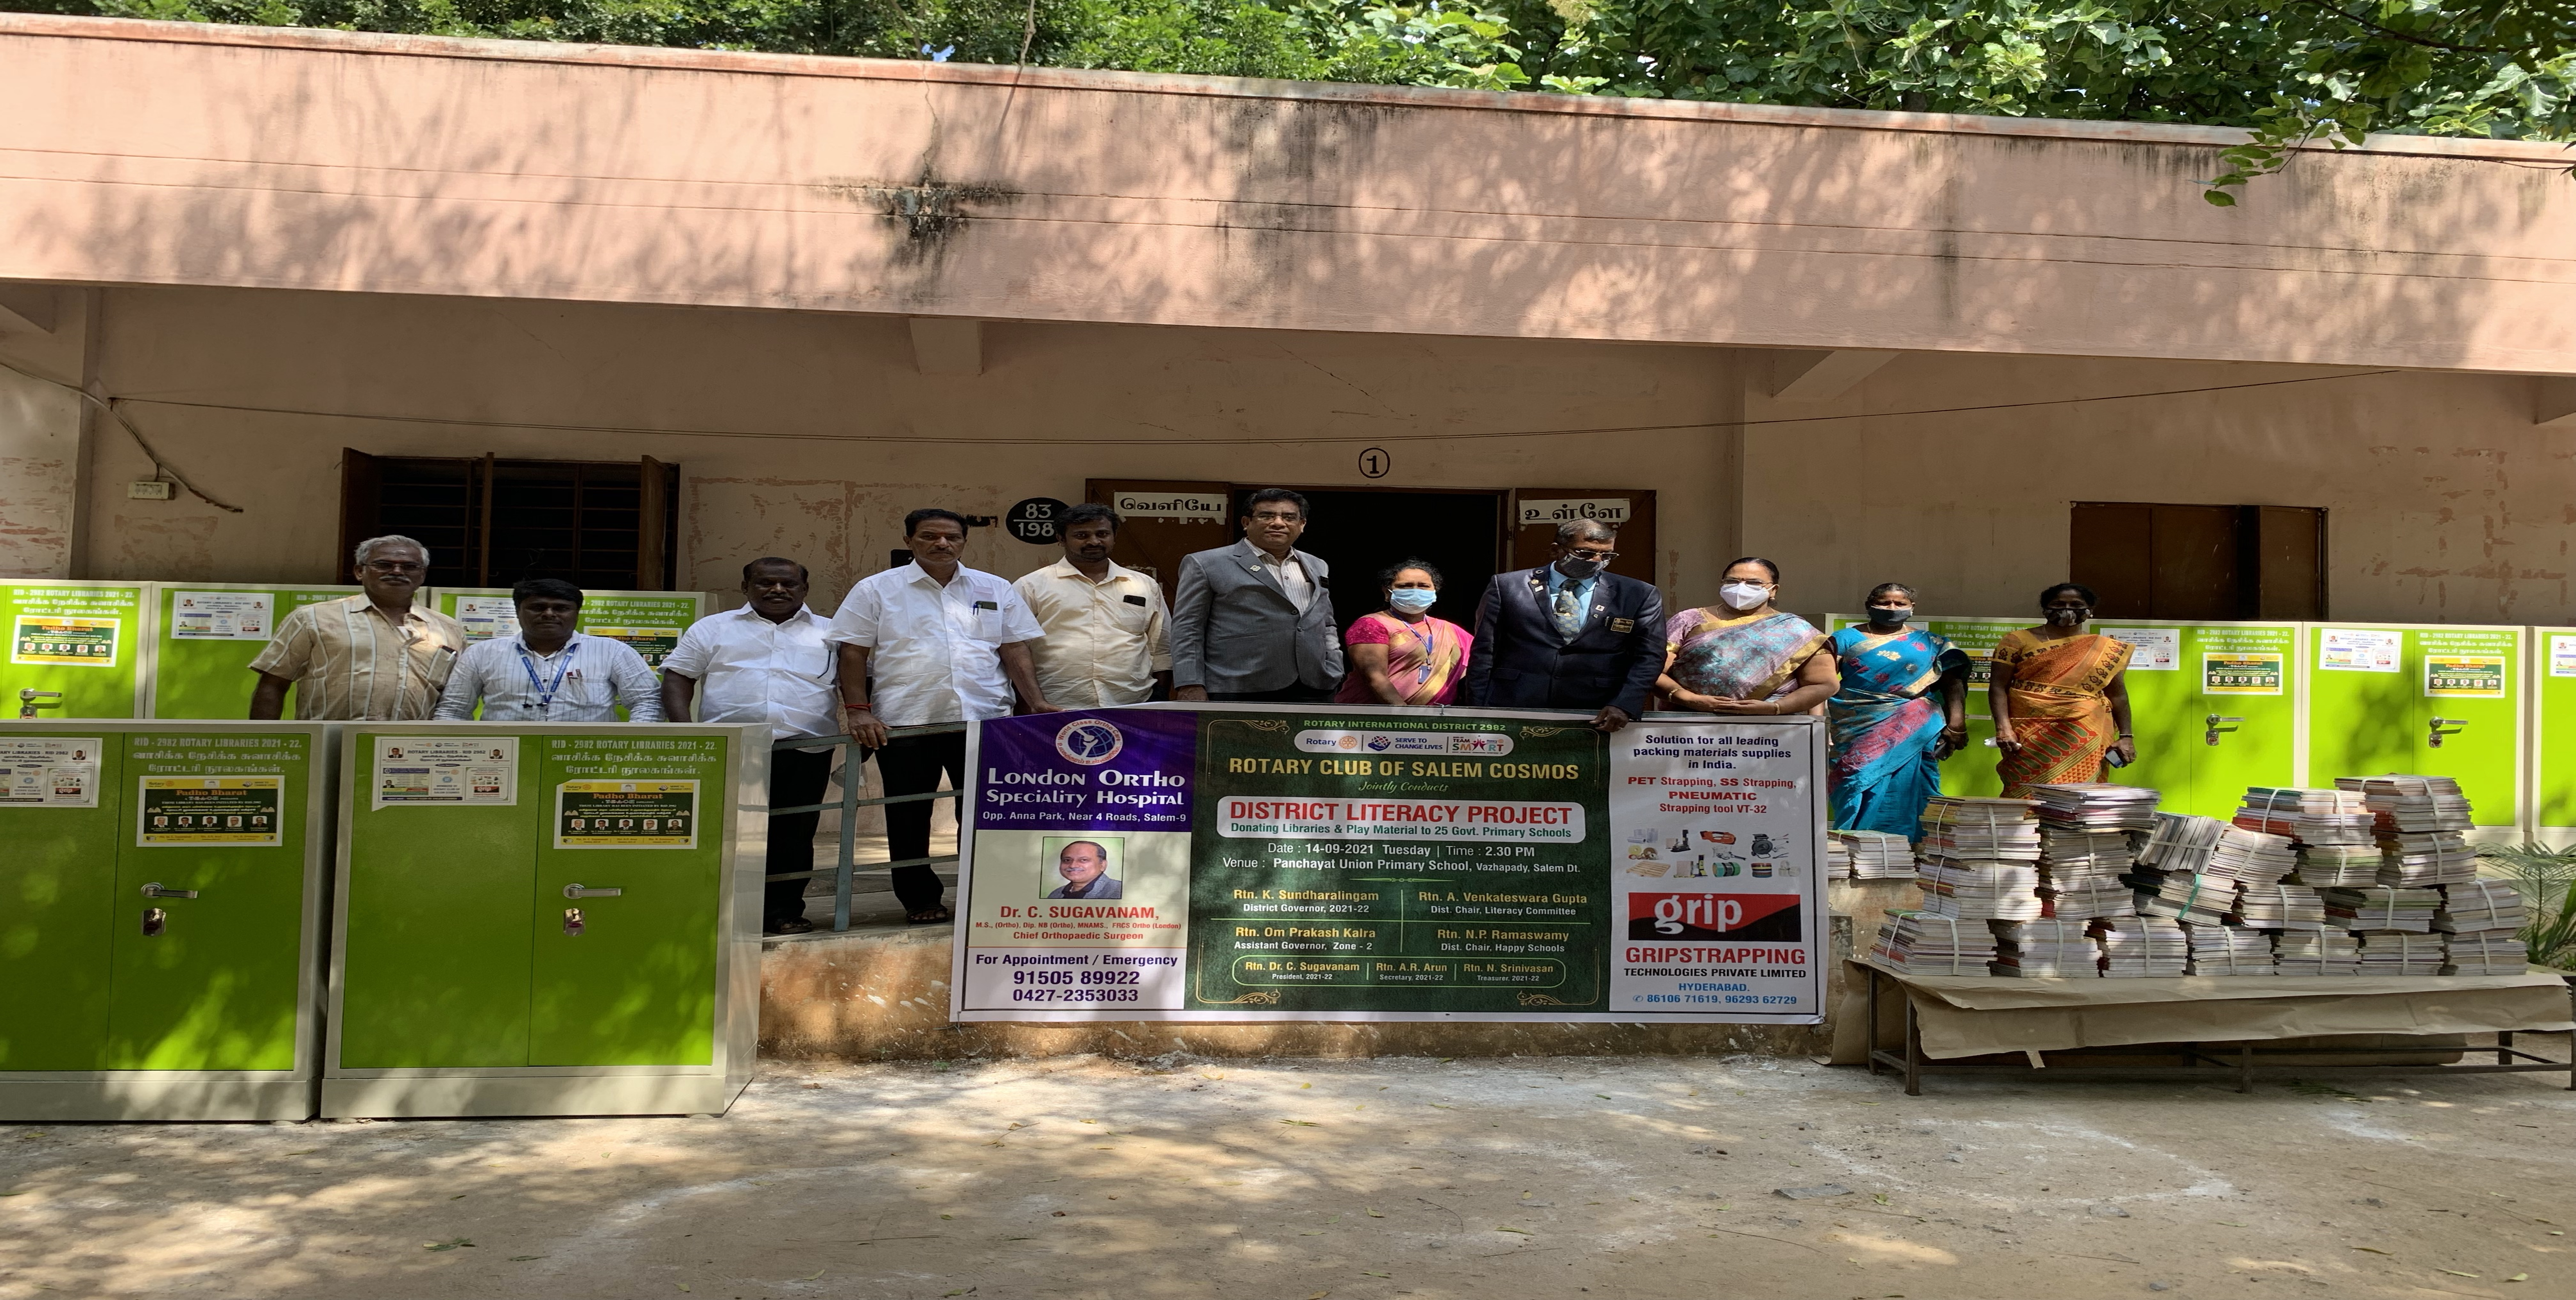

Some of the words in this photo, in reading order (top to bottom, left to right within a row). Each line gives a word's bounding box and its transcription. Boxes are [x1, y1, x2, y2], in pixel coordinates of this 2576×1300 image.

[1366, 455, 1379, 474] 1
[1025, 503, 1051, 519] 83
[1120, 497, 1222, 512] வெளியே
[1524, 502, 1624, 520] உள்ளே
[1018, 522, 1055, 537] 198
[1057, 726, 1072, 740] World
[1094, 720, 1113, 730] Ortho
[1112, 730, 1121, 741] Care
[1348, 721, 1430, 729] INTERNATIONAL
[134, 737, 149, 746] RID
[180, 738, 212, 747] ROTARY
[215, 739, 259, 747] LIBRARIES
[262, 739, 281, 748] 2021
[552, 740, 566, 749] RID
[596, 740, 629, 749] ROTARY
[631, 741, 675, 750] LIBRARIES
[677, 741, 697, 750] 2021
[1306, 738, 1336, 746] Rotary
[1645, 735, 1694, 744] Solution
[1698, 736, 1714, 744] for
[1718, 736, 1732, 745] all
[1736, 737, 1778, 747] leading
[1633, 747, 1680, 758] packing
[1684, 748, 1738, 757] materials
[1742, 749, 1791, 759] supplies
[1229, 758, 1313, 774] ROTARY
[1320, 760, 1372, 776] CLUB
[1380, 761, 1404, 776] OF
[1412, 761, 1482, 778] SALEM
[1489, 763, 1579, 780] COSMOS
[1358, 780, 1398, 793] Jointly
[1401, 781, 1449, 792] Conducts
[1661, 777, 1716, 787] Strapping,
[1743, 779, 1796, 789] Strapping,
[1669, 791, 1757, 800] PNEUMATIC
[983, 811, 1005, 820] Opp.
[1039, 812, 1065, 821] Park,
[1106, 813, 1141, 822] Roads,
[1231, 801, 1339, 820] DISTRICT
[1347, 803, 1460, 822] LITERACY
[1468, 806, 1572, 824] PROJECT
[1231, 823, 1279, 834] Donating
[1283, 823, 1330, 833] Libraries
[1347, 825, 1370, 835] Play
[1374, 825, 1417, 835] Material
[1434, 826, 1448, 835] 25
[1452, 827, 1479, 836] Govt.
[1483, 827, 1525, 838] Primary
[1529, 828, 1571, 837] Schools
[1268, 843, 1293, 853] Date
[1305, 844, 1374, 854] 14-09-2021
[1382, 845, 1431, 857] Tuesday
[1445, 846, 1474, 856] Time
[1485, 847, 1511, 856] 2.30
[1515, 847, 1535, 857] PM
[1223, 857, 1258, 868] Venue
[1273, 858, 1335, 870] Panchayat
[1339, 859, 1373, 869] Union
[1378, 860, 1425, 872] Primary
[1429, 860, 1472, 872] School,
[1476, 862, 1530, 873] Vazhapady,
[1533, 864, 1564, 872] Salem
[1234, 890, 1258, 899] Rtn.
[1262, 890, 1274, 899] K.
[1279, 890, 1379, 902] Sundharalingam
[1419, 892, 1443, 902] Rtn.
[1446, 892, 1459, 902] A.
[1463, 893, 1548, 903] Venkateswara
[1552, 894, 1587, 905] Gupta
[1001, 906, 1021, 918] Dr.
[1027, 907, 1042, 918] C.
[1049, 907, 1159, 920] SUGAVANAM,
[1654, 894, 1742, 934] grip
[1042, 931, 1100, 940] Orthopaedic
[1437, 929, 1461, 939] Rtn.
[1491, 930, 1569, 941] Ramaswamy
[976, 954, 998, 964] For
[1002, 954, 1088, 966] Appointment
[1103, 955, 1178, 967] Emergency
[1626, 947, 1805, 964] GRIPSTRAPPING
[1013, 971, 1073, 985] 91505
[1081, 971, 1140, 985] 89922
[1624, 968, 1708, 977] TECHNOLOGIES
[1711, 969, 1757, 977] PRIVATE
[1761, 969, 1806, 978] LIMITED
[1679, 983, 1750, 992] HYDERABAD.
[1013, 989, 1139, 1002] 0427-2353033
[1685, 995, 1721, 1004] 71619,
[1725, 995, 1759, 1004] 96293
[1762, 996, 1797, 1004] 62729
